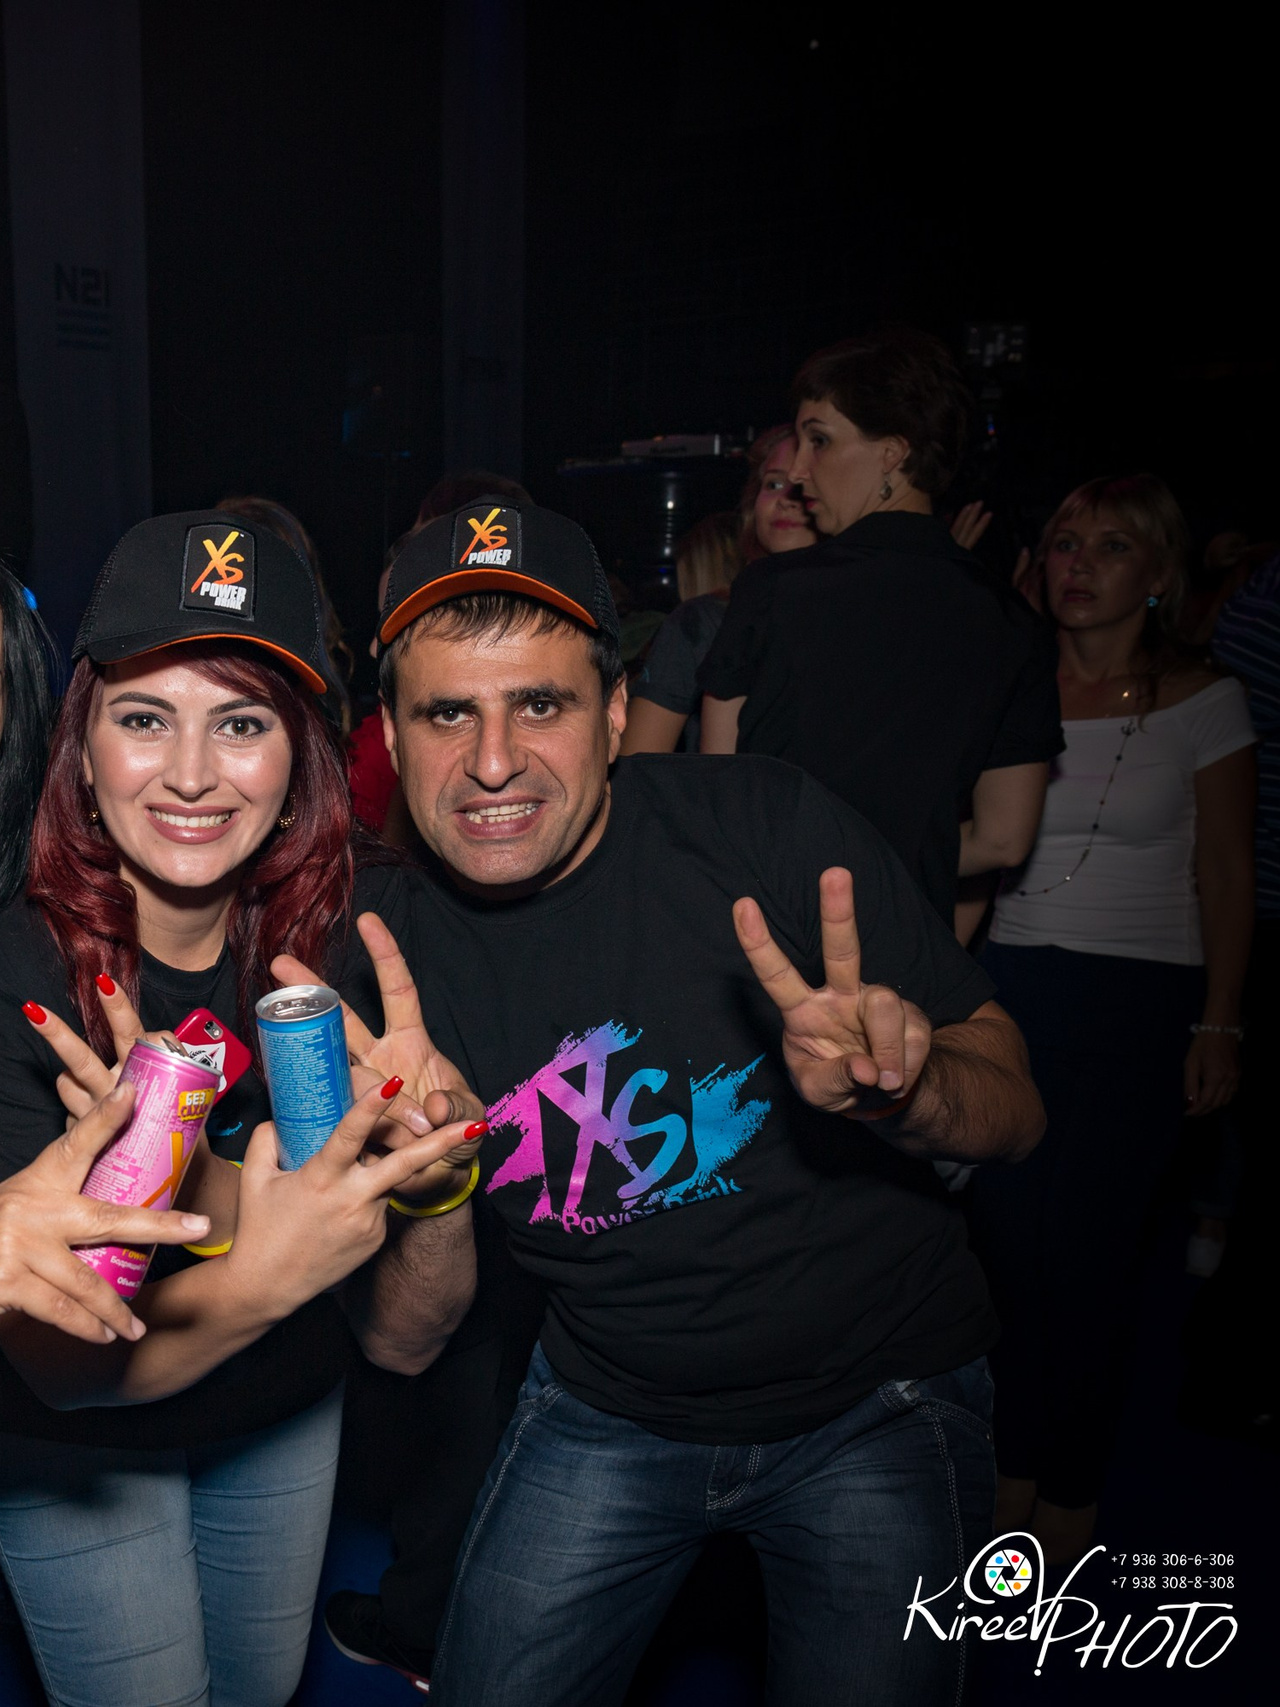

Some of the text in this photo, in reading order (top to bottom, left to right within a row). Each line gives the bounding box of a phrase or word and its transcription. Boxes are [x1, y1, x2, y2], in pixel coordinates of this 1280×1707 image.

[467, 549, 512, 565] POWER
[200, 581, 246, 602] POWER
[186, 1092, 206, 1106] БЕЗ
